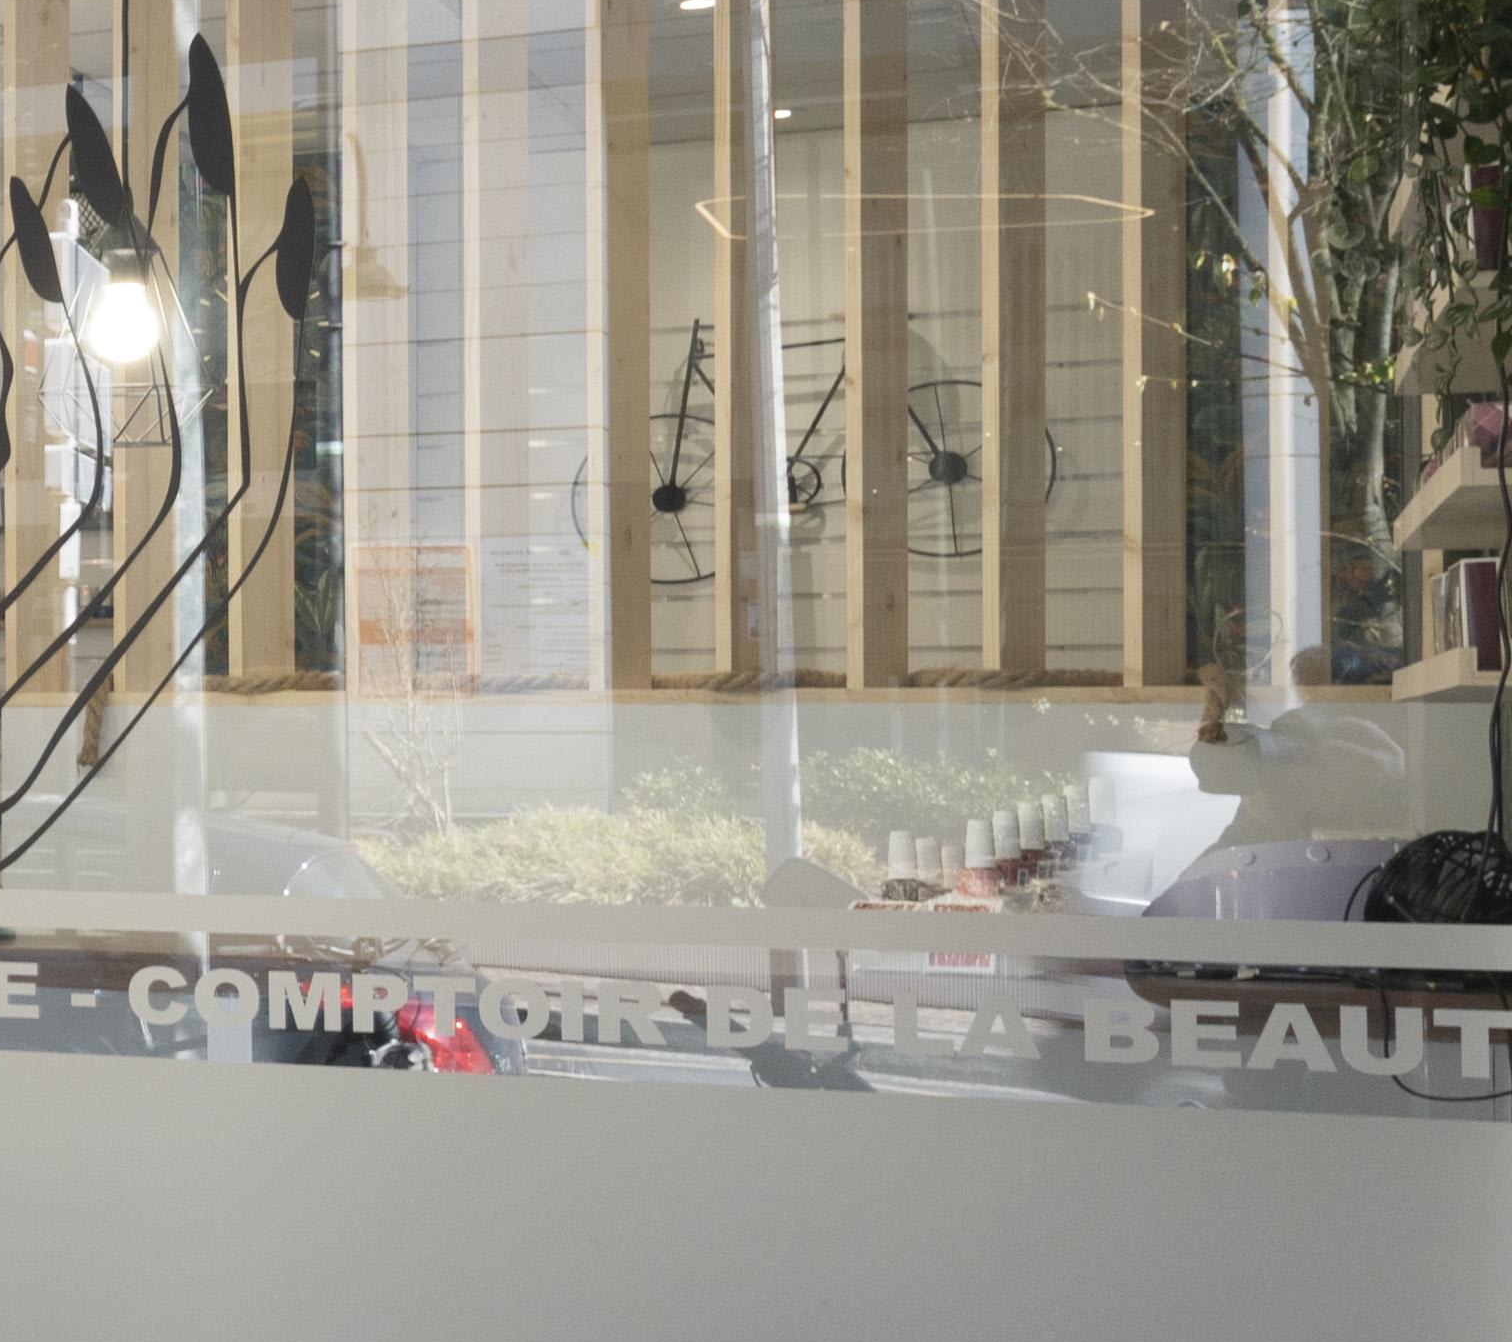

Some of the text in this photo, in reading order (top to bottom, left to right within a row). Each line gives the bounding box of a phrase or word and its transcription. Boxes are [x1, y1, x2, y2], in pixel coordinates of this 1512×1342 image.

[128, 964, 665, 1047] COMPTOIR
[706, 986, 849, 1053] DE
[893, 993, 1041, 1061] LA
